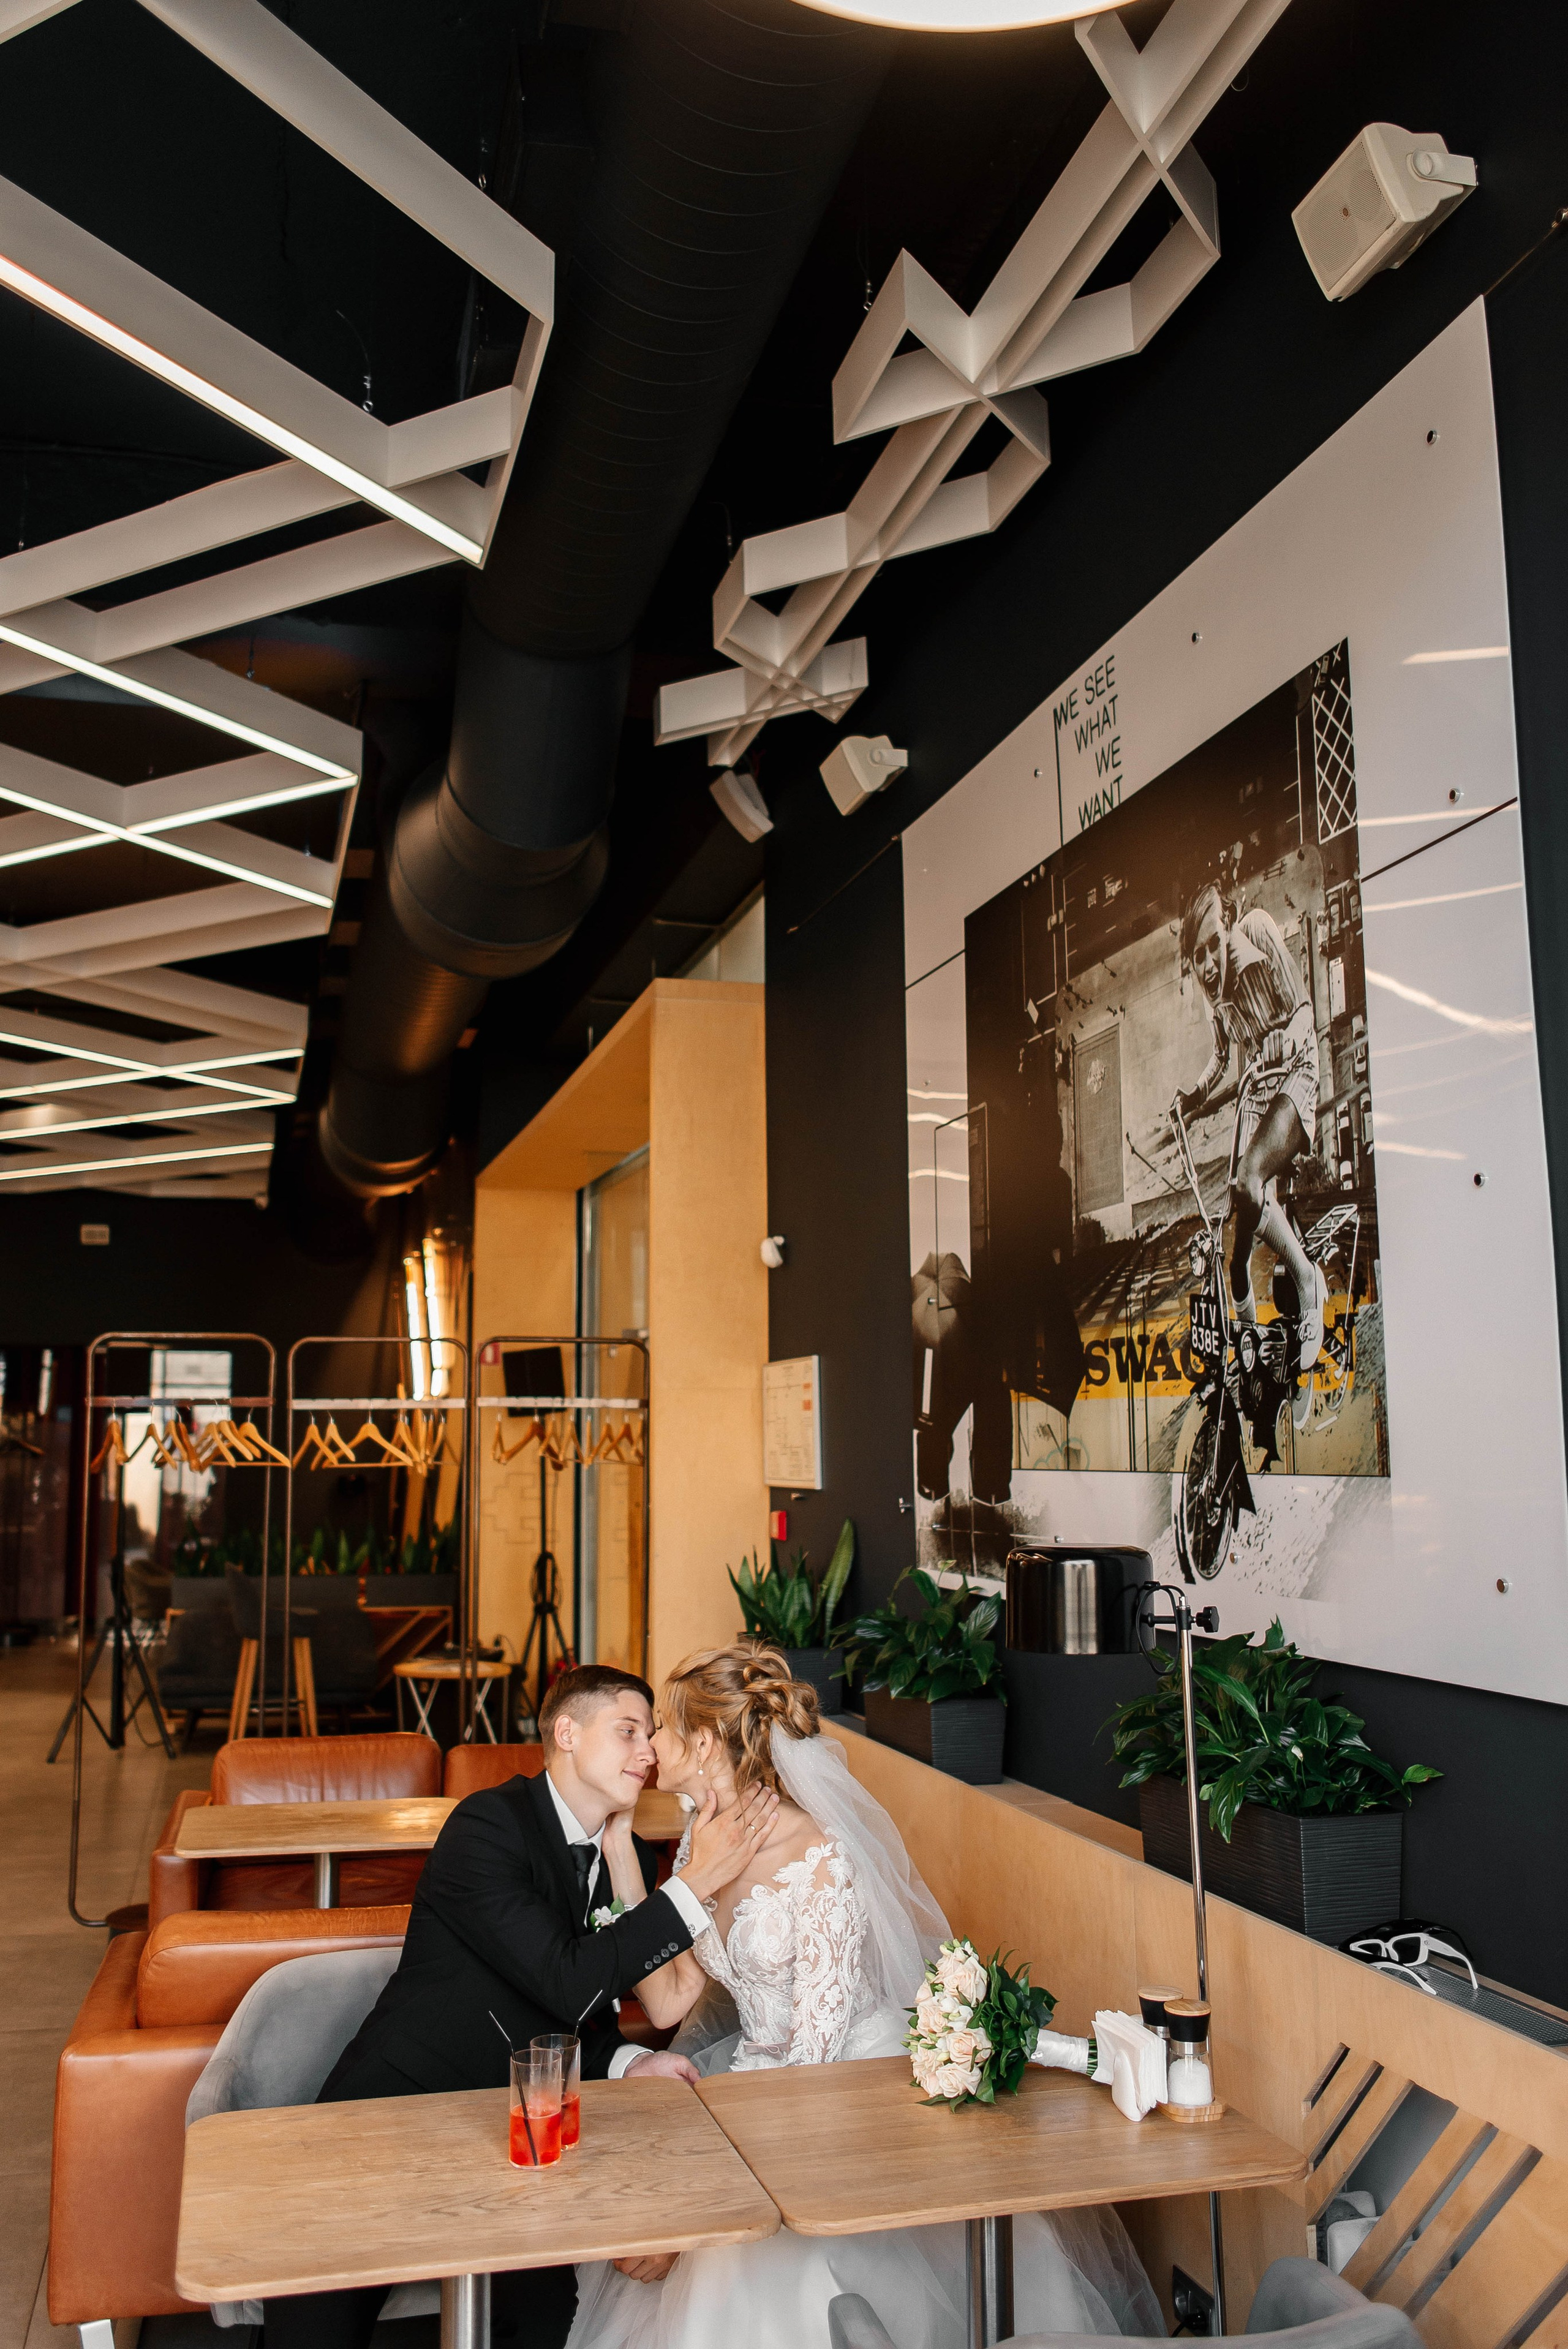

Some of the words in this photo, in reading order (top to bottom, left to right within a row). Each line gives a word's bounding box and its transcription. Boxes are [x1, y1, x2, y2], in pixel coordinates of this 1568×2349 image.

[1053, 688, 1079, 730] WE
[1084, 654, 1115, 705] SEE
[1074, 693, 1118, 755] WHAT
[1095, 735, 1122, 778] WE
[1078, 774, 1123, 831] WANT
[1191, 1301, 1216, 1329] JTV
[1191, 1325, 1220, 1356] 838E
